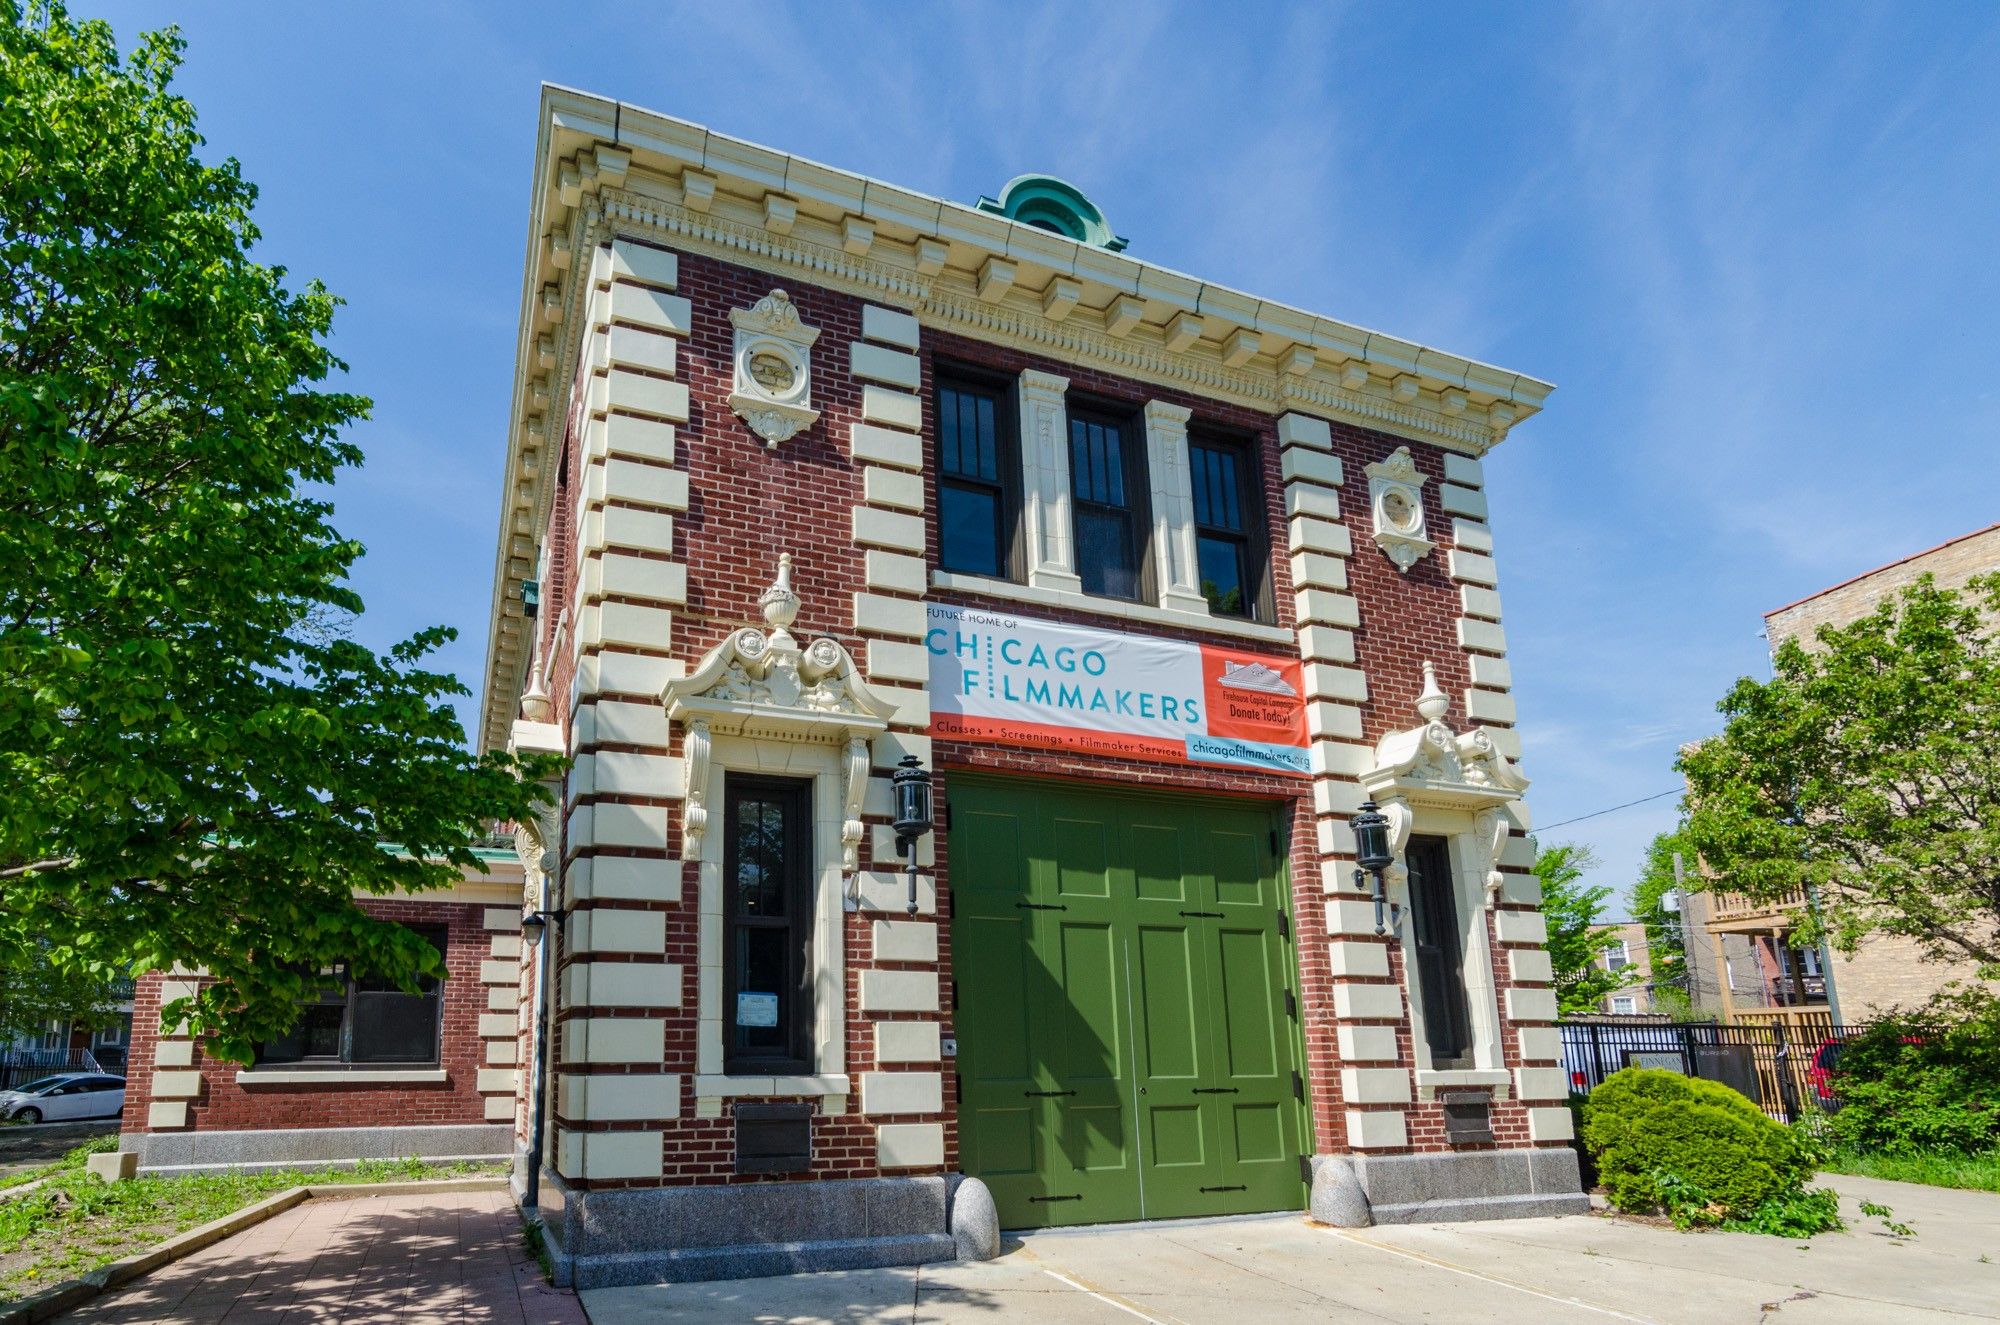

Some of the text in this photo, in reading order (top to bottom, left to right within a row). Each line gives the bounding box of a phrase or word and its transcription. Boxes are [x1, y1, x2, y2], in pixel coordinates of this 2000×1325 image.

[926, 608, 1018, 629] FUTURE HOME OF
[924, 628, 1106, 676] CHICAGO
[963, 668, 1201, 724] FILMMAKERS
[1222, 690, 1248, 703] Firehouse
[1249, 694, 1268, 707] Capital
[1230, 704, 1291, 726] Donate Today!
[936, 721, 1182, 757] Classes Screenings Filmmaker Services
[1192, 740, 1310, 769] chicagofilmmakers.org
